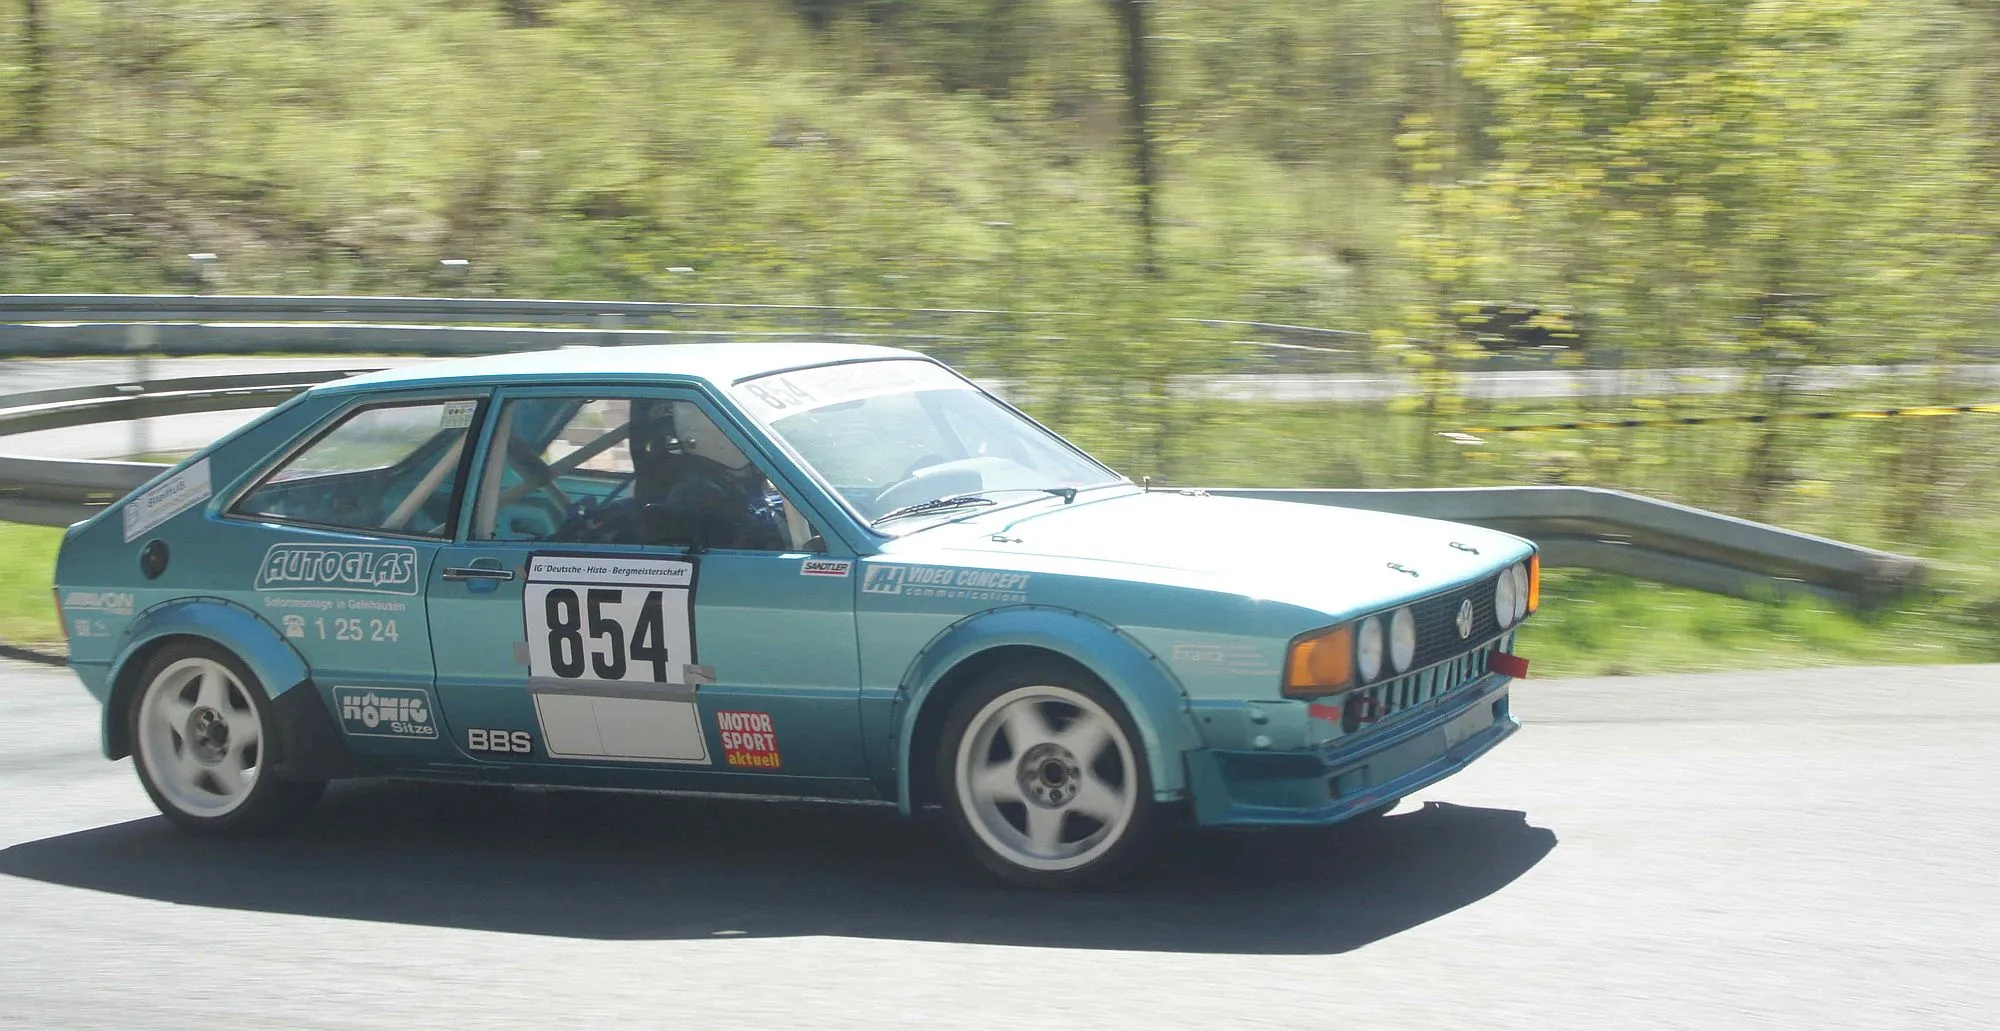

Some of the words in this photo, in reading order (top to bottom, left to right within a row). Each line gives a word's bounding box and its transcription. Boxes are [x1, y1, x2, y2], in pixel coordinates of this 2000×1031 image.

[744, 377, 817, 410] 854
[264, 551, 413, 586] AUTOGLAS
[533, 564, 543, 573] IG
[586, 565, 607, 575] Histo
[907, 567, 954, 586] VIDEO
[956, 571, 1032, 590] CONCEPT
[337, 599, 346, 609] in
[906, 587, 1028, 603] communications
[313, 617, 327, 640] 1
[335, 617, 364, 641] 25
[370, 618, 399, 642] 24
[545, 588, 669, 684] 854
[391, 721, 434, 735] Sitze
[717, 712, 772, 732] MOTOR
[468, 728, 532, 753] BBS
[721, 731, 775, 751] SPORT
[727, 750, 781, 768] aktuell
